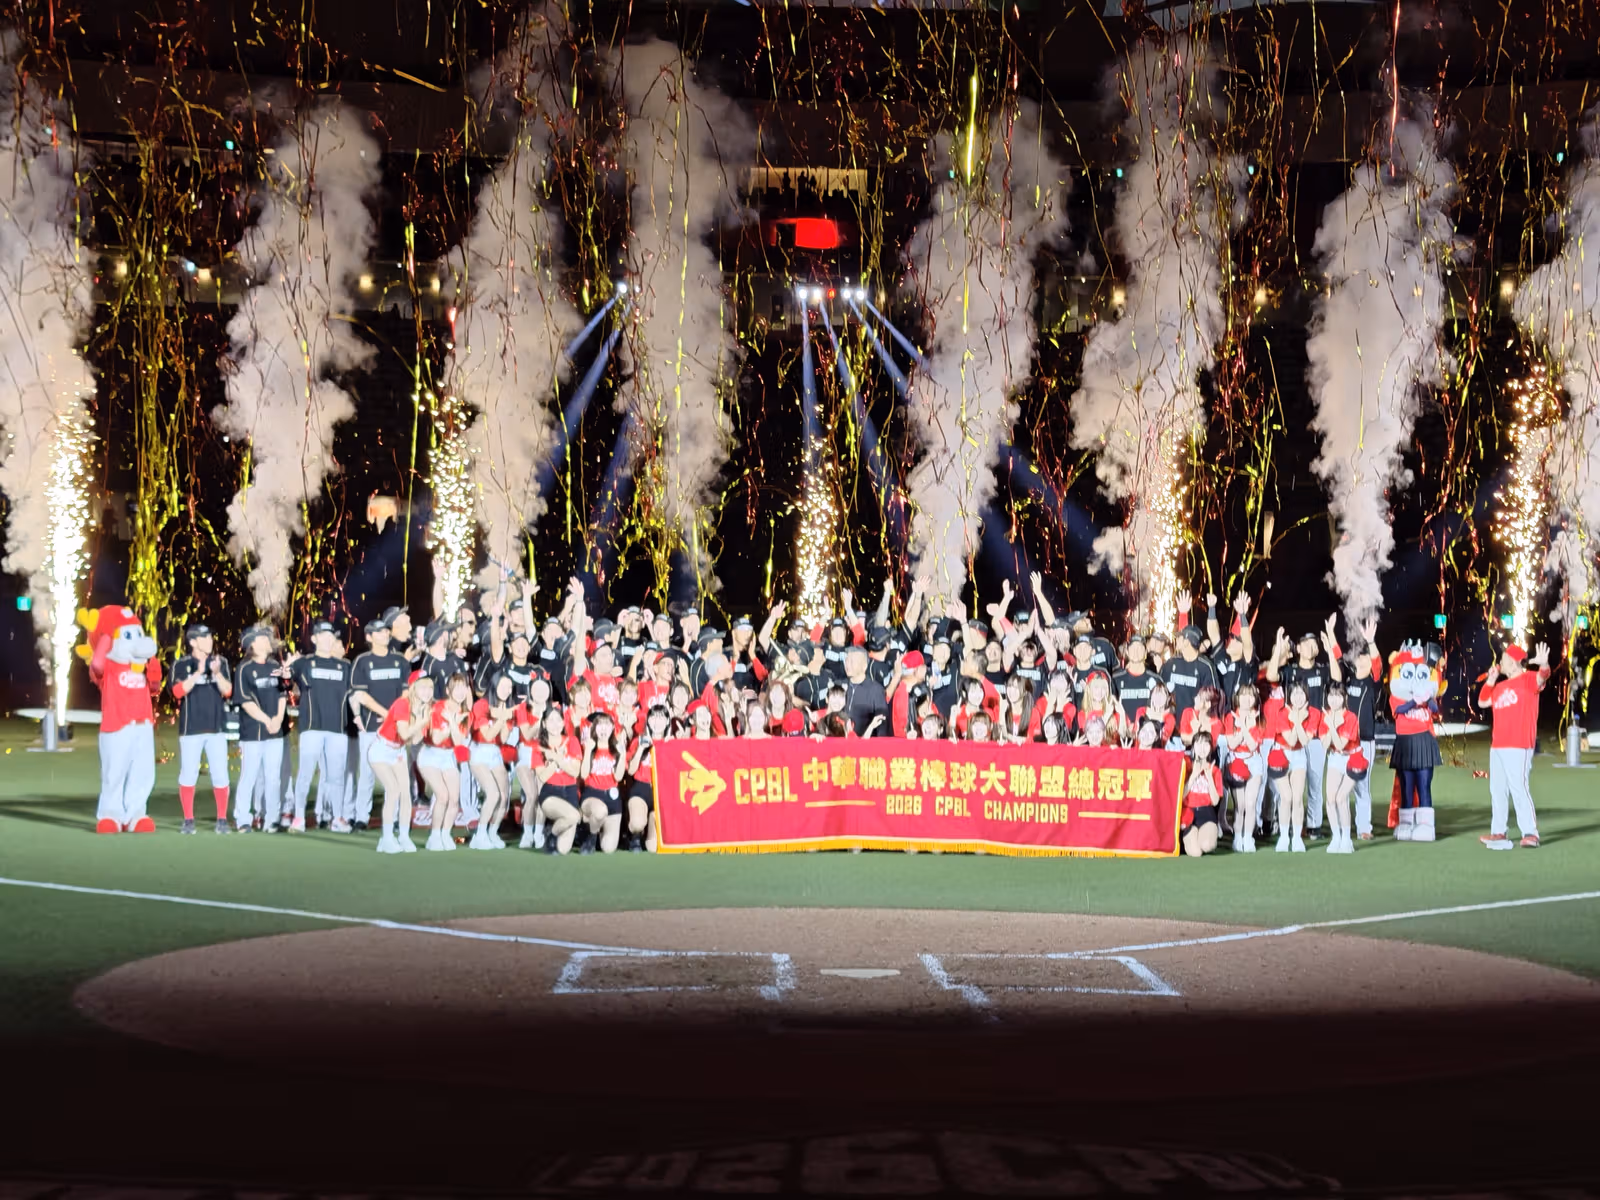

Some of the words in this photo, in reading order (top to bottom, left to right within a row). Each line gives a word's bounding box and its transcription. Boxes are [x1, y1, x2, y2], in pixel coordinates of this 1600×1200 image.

[734, 766, 798, 804] CPBL
[802, 755, 1153, 802] 中華職業棒球大聯盟總冠軍
[885, 794, 923, 815] 2026
[934, 795, 972, 817] CPBL
[983, 799, 1069, 824] CHAMPIONS
